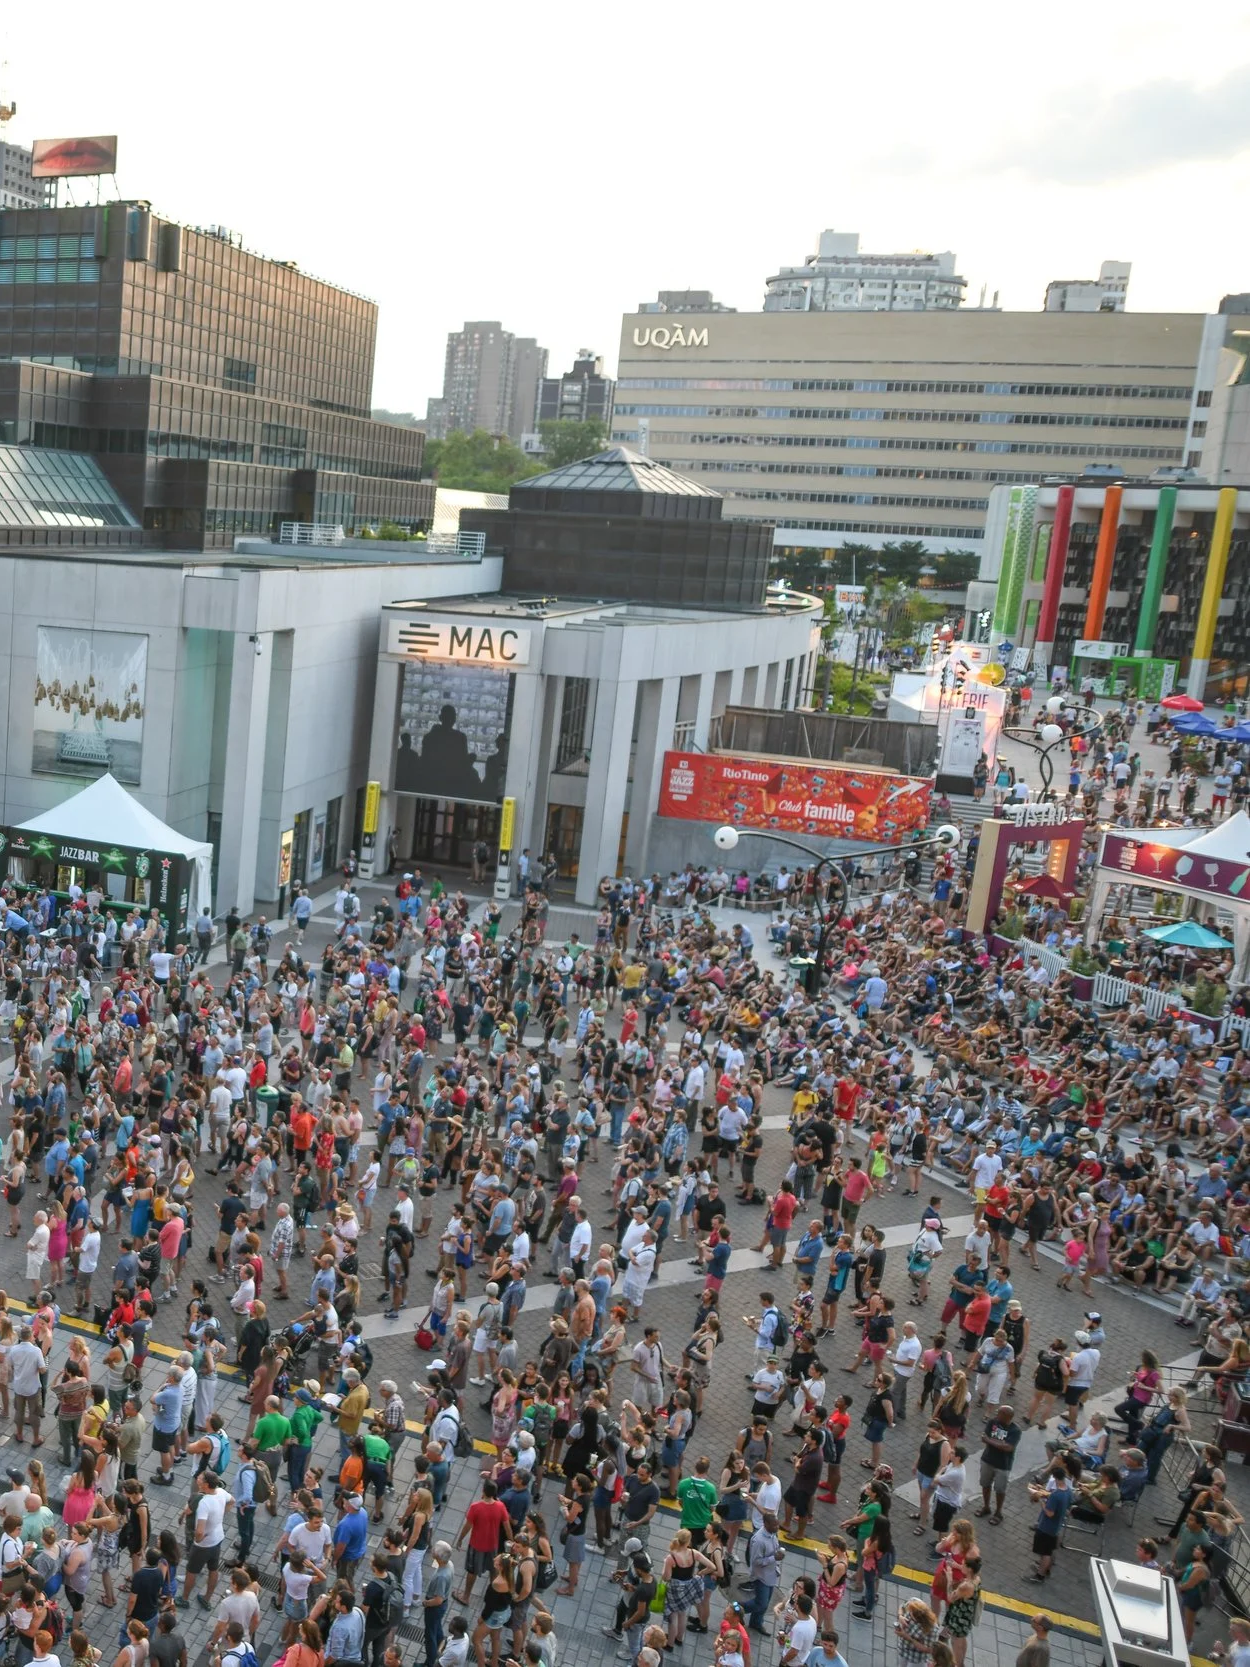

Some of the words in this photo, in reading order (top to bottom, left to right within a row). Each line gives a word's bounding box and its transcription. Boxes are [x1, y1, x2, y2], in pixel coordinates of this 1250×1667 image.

[633, 323, 709, 349] UQÀM
[449, 625, 518, 661] MAC
[778, 800, 801, 813] Club
[804, 802, 855, 823] famille
[1014, 803, 1066, 828] BISTRO
